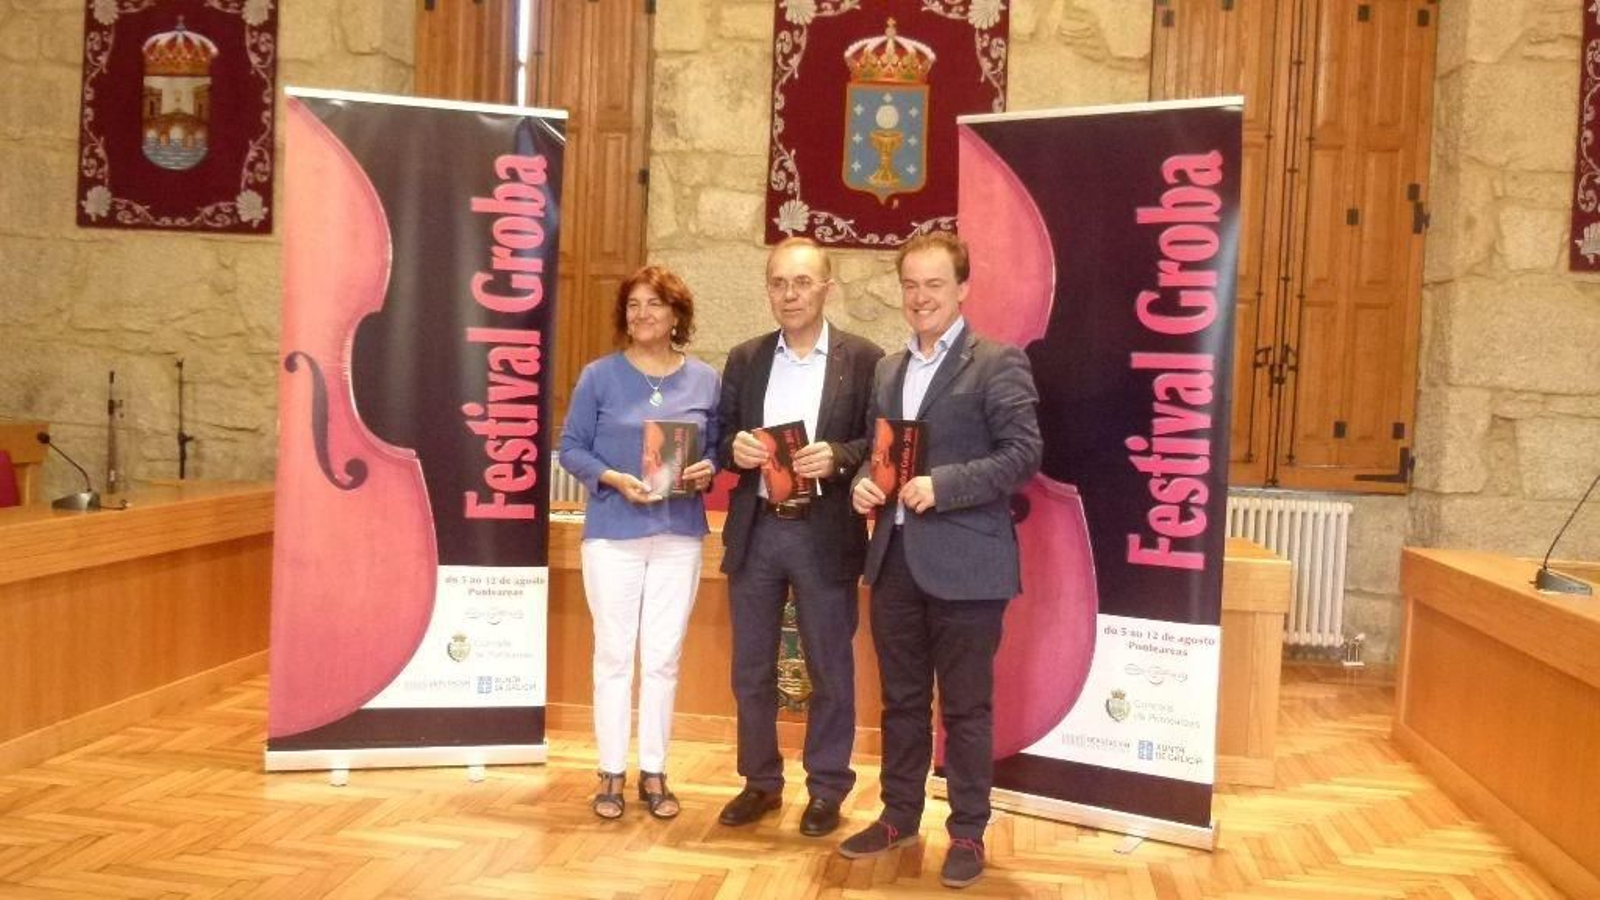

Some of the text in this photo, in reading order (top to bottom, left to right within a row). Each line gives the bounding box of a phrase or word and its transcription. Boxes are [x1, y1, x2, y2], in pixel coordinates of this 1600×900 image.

[471, 155, 548, 314] Groba
[1136, 149, 1223, 335] Groba
[463, 328, 541, 519] Festival
[1127, 353, 1213, 571] Festival
[486, 576, 497, 585] 12
[1104, 625, 1118, 636] do
[1130, 629, 1143, 639] ao
[1147, 630, 1159, 640] 12
[1161, 632, 1175, 642] de
[1177, 636, 1215, 647] agosto
[1128, 641, 1189, 657] Ponteareas
